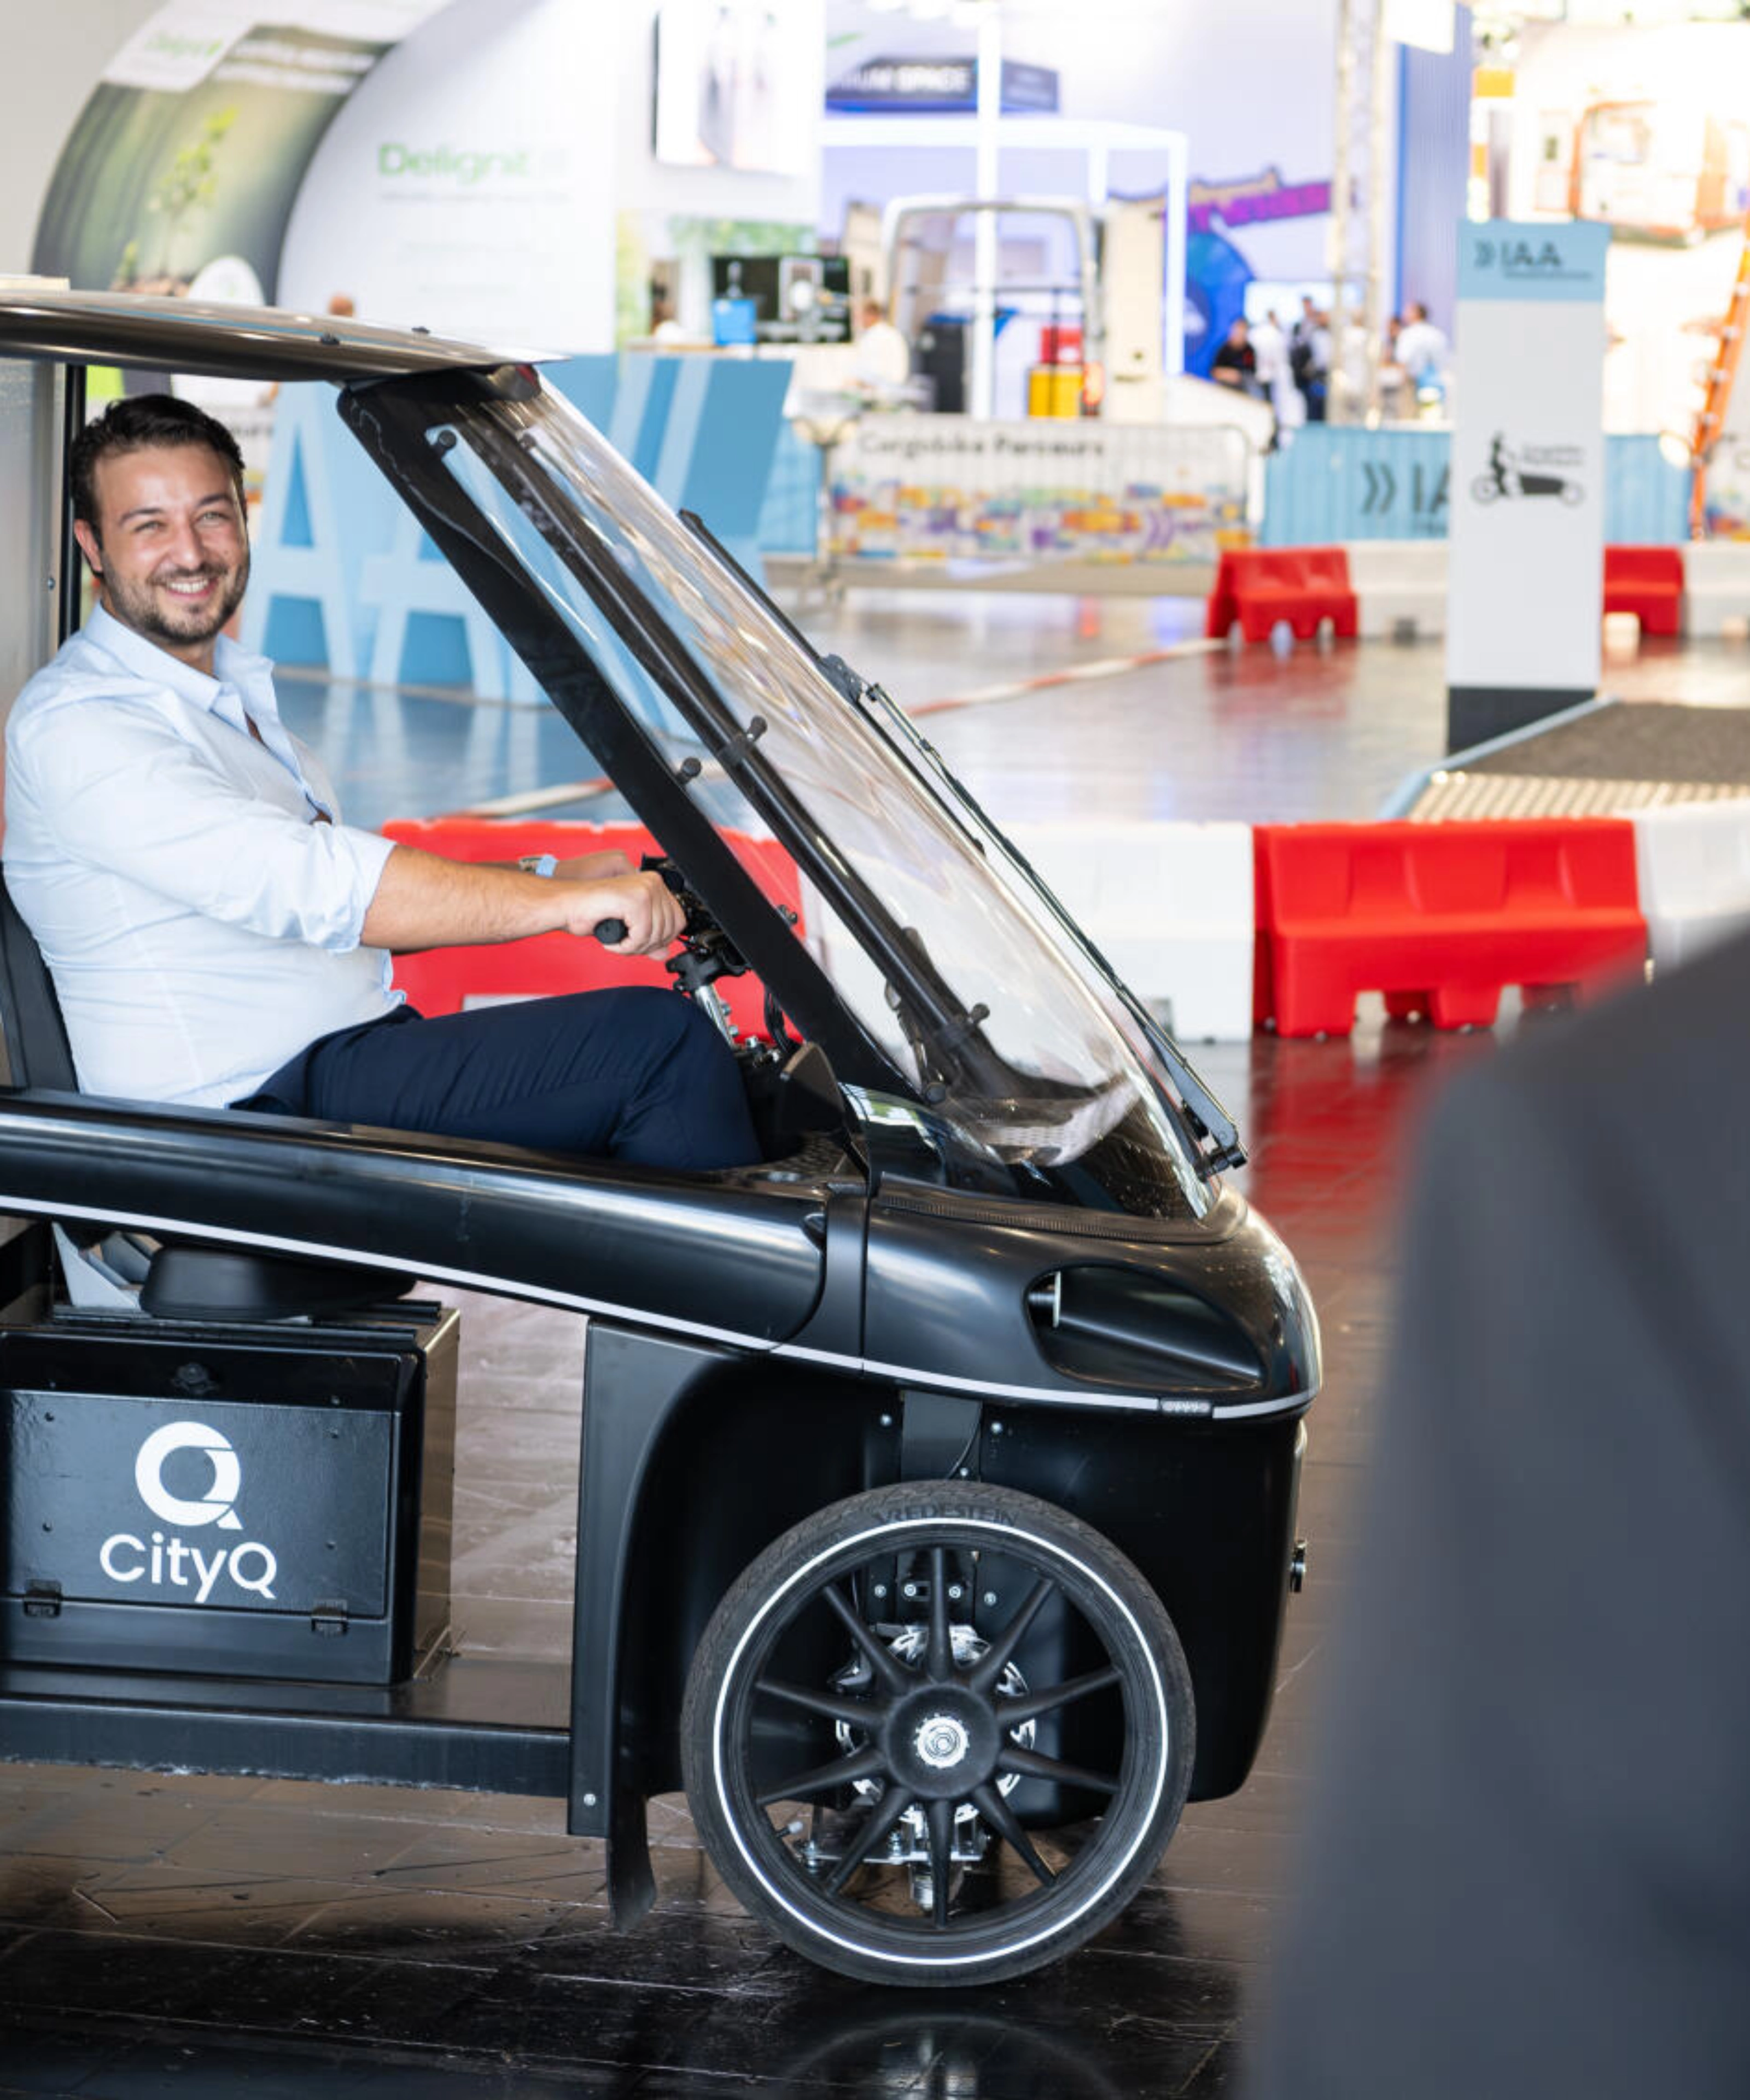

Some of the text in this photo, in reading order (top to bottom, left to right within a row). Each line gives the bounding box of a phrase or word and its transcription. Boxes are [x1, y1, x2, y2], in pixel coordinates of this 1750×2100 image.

[1501, 240, 1562, 266] IAA
[858, 432, 1106, 459] Cargobike Parcours
[872, 1502, 1022, 1527] VREDESTEIN
[100, 1532, 278, 1603] CityQ
